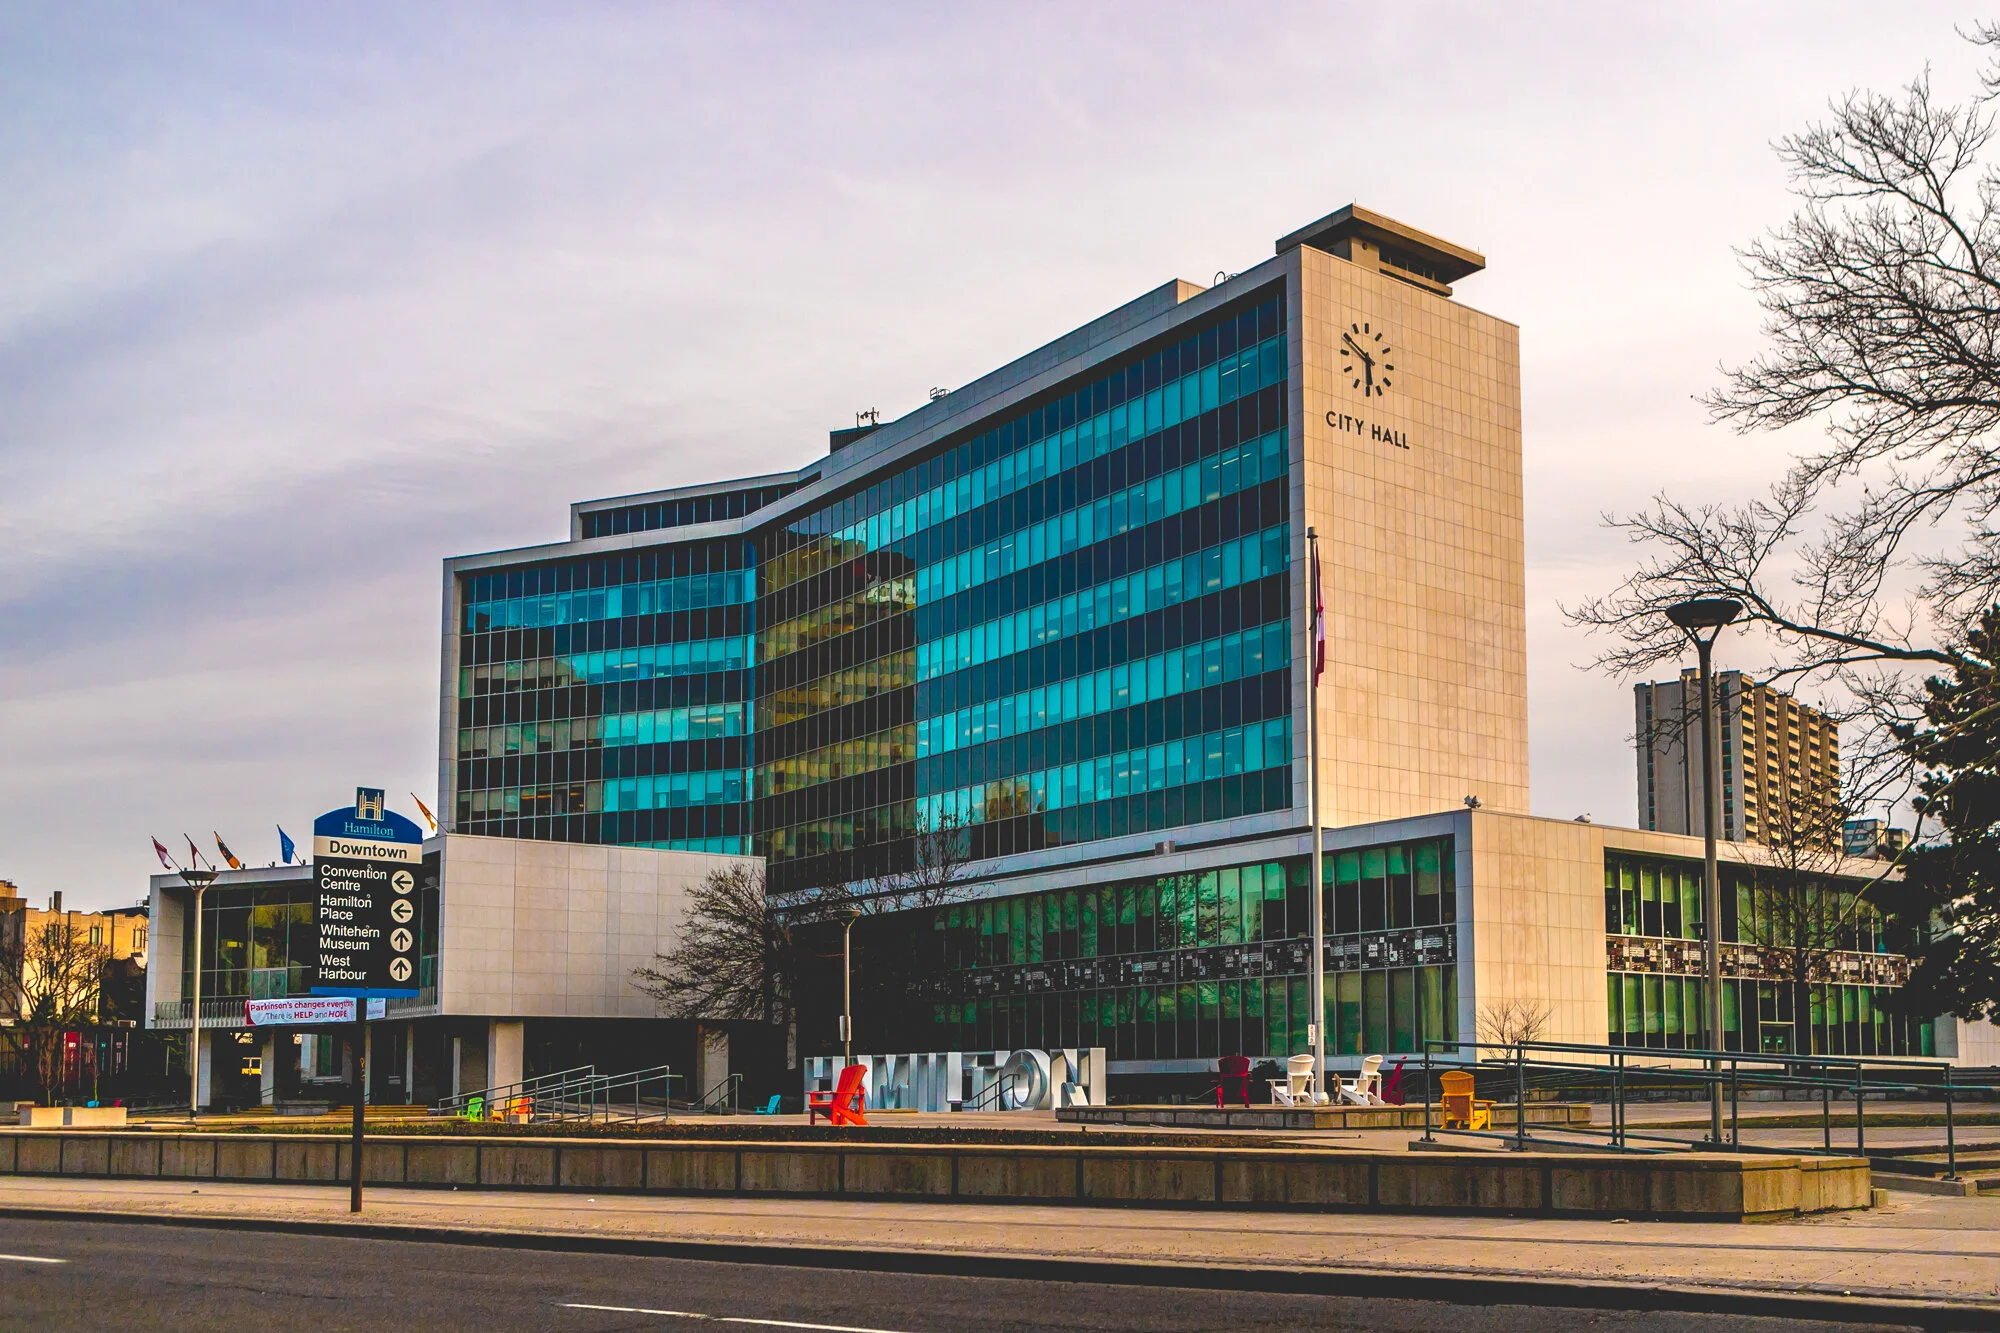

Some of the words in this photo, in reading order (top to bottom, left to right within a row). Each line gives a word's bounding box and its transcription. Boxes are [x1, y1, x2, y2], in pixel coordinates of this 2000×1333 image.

[1325, 410, 1364, 435] CITY
[1371, 423, 1410, 450] HALL
[344, 821, 394, 836] Hamilton
[329, 840, 408, 859] Downtown
[321, 864, 387, 880] Convention
[321, 877, 361, 892] Centre
[320, 893, 372, 909] Hamilton
[320, 907, 354, 921] Place
[320, 923, 380, 938] Whitehern
[319, 936, 370, 951] Museum
[320, 953, 351, 967] West
[318, 967, 367, 980] Harbour
[250, 1001, 293, 1011] Parkinson's
[294, 1000, 326, 1009] changes
[266, 1012, 285, 1020] There
[286, 1011, 293, 1019] is
[294, 1011, 313, 1019] HELP
[328, 1010, 348, 1018] HOPE
